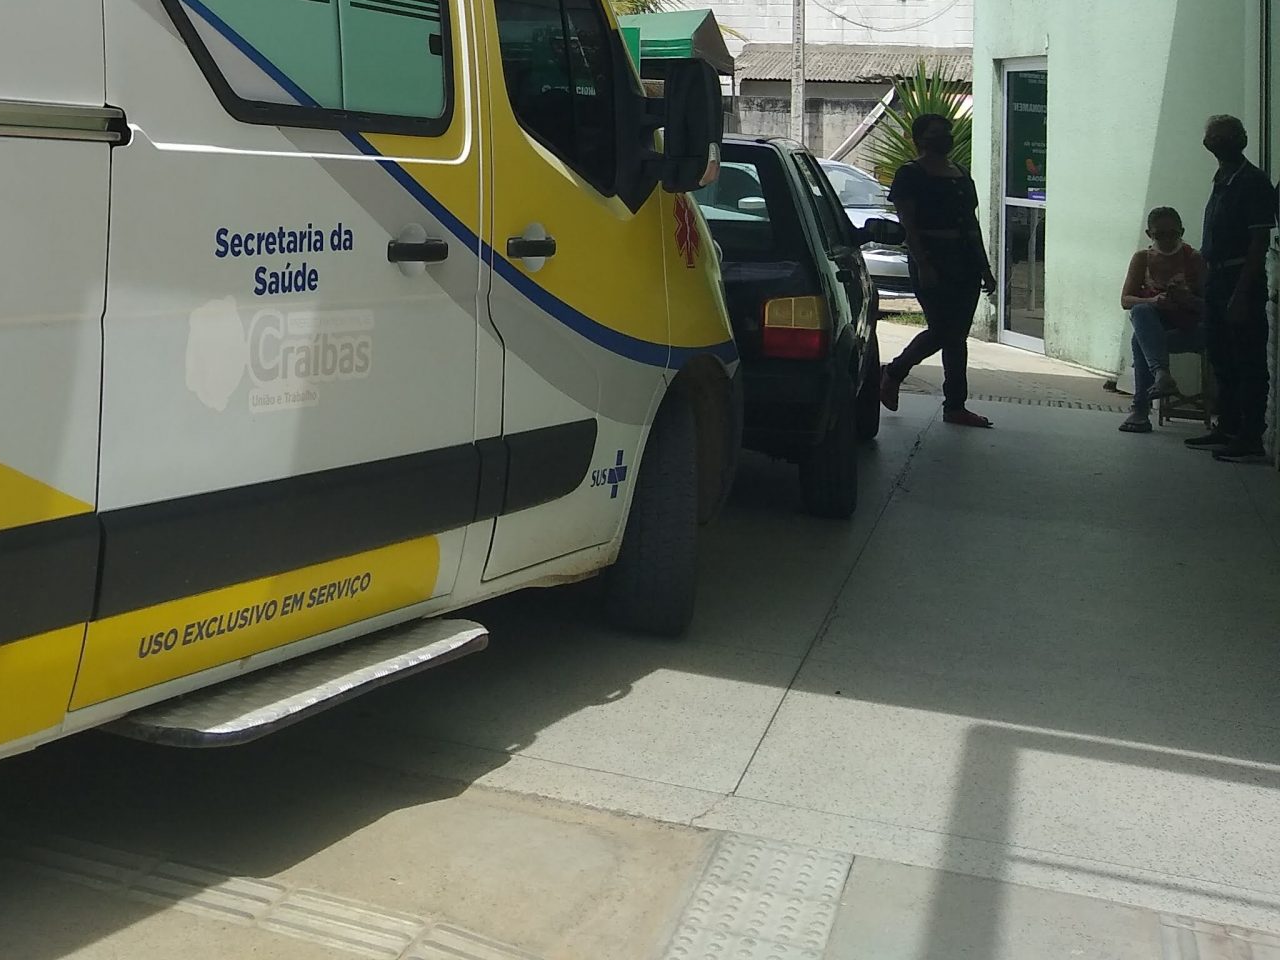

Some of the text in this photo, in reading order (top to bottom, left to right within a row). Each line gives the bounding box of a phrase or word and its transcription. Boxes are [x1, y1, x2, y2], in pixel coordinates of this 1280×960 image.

[215, 223, 353, 258] Secretaria da
[254, 262, 319, 296] Saúde
[250, 312, 370, 382] Craíbas
[590, 468, 608, 488] SUS
[138, 572, 372, 658] USO EXCLUSIVO EM SERVIÇO
